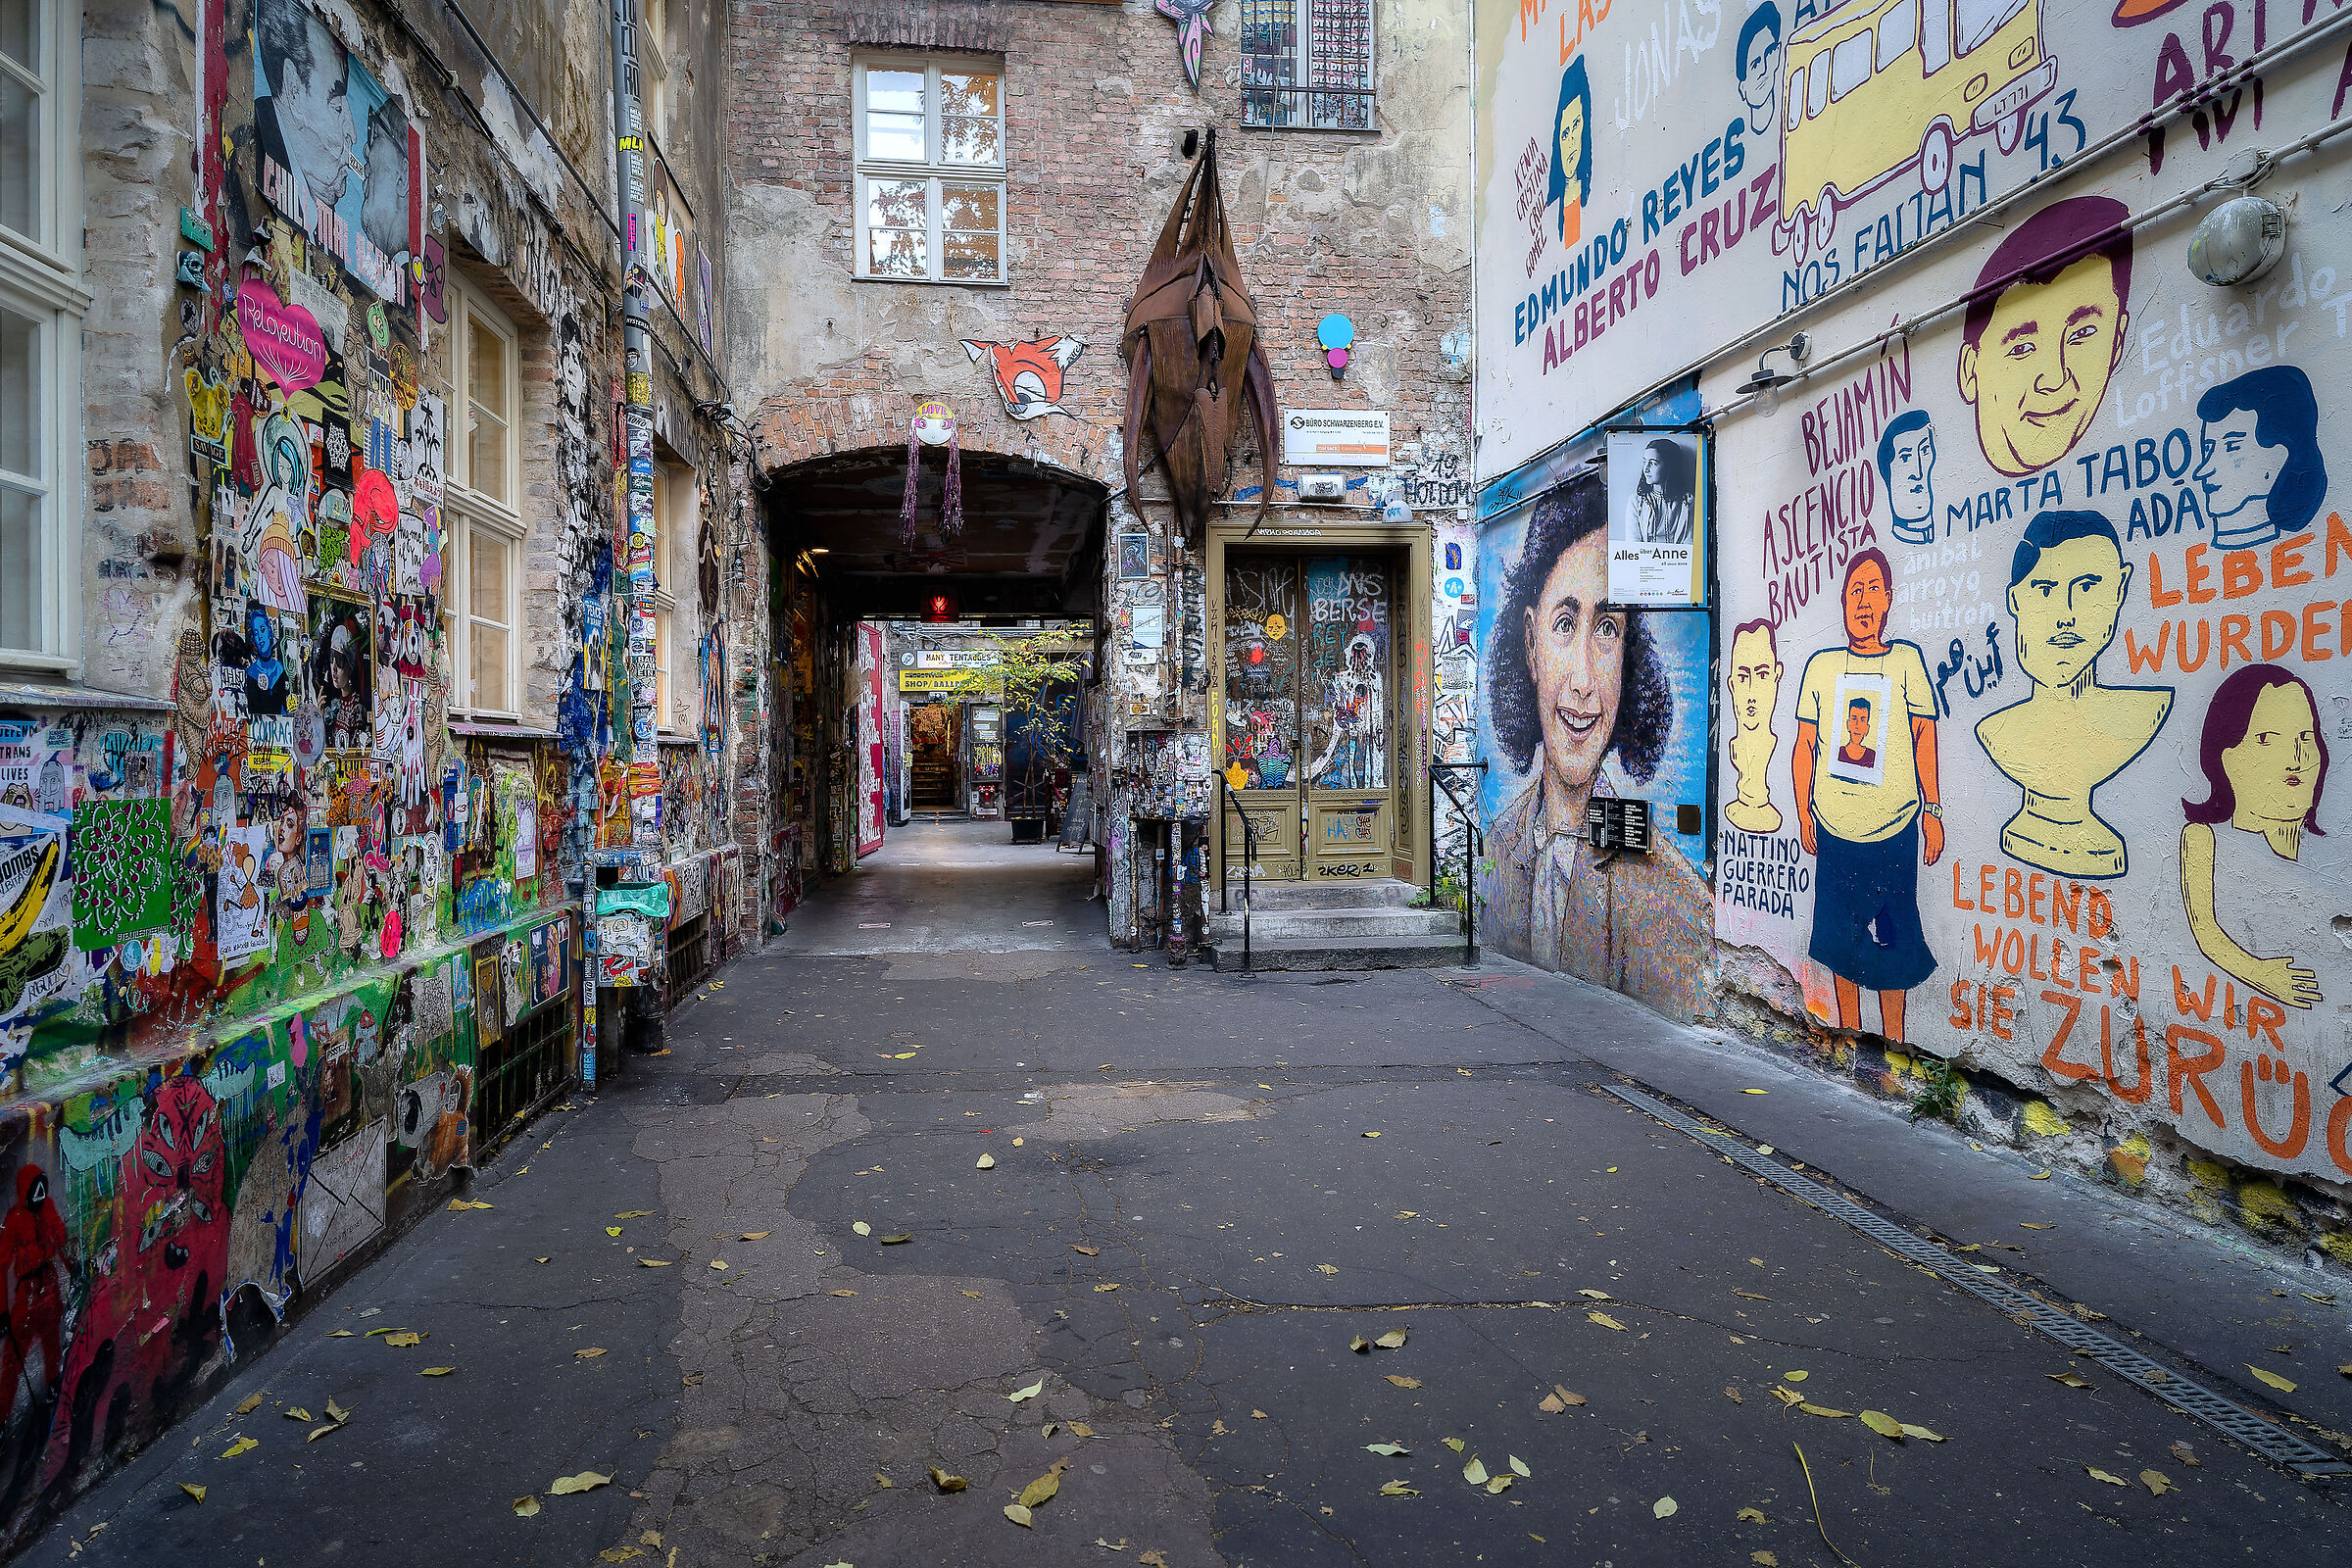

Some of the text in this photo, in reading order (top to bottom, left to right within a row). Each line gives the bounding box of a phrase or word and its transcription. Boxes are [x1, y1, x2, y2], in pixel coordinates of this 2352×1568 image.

[1514, 136, 1540, 189] KENIA
[1515, 152, 1548, 221] CRISTINA
[1514, 117, 1745, 347] EDMUNDO REYES
[1528, 190, 1547, 236] CRUZ
[1778, 248, 1840, 318] NOS
[2024, 88, 2086, 179] 43
[1543, 163, 1777, 376] ALBERTO CRUZ
[2141, 253, 2336, 375] Eduardo
[921, 404, 948, 416] LOVE
[1305, 417, 1322, 427] BÜRO
[1323, 419, 1373, 428] SCHWARZENBERG
[1763, 458, 1876, 579] ASCENCIO
[1946, 469, 2063, 537] MARTA
[1614, 551, 1640, 561] Alles
[1652, 547, 1688, 560] Anne
[1768, 517, 1877, 630] BAUTISTA
[1, 767, 28, 781] LIVES
[1723, 858, 1809, 893] GUERRERO
[1724, 830, 1800, 864] NATTINO
[1723, 883, 1794, 920] PARADA
[1952, 860, 2113, 940] LEBEND
[1948, 979, 2016, 1041] SIE
[1974, 923, 2286, 1053] WOLLEN WIR
